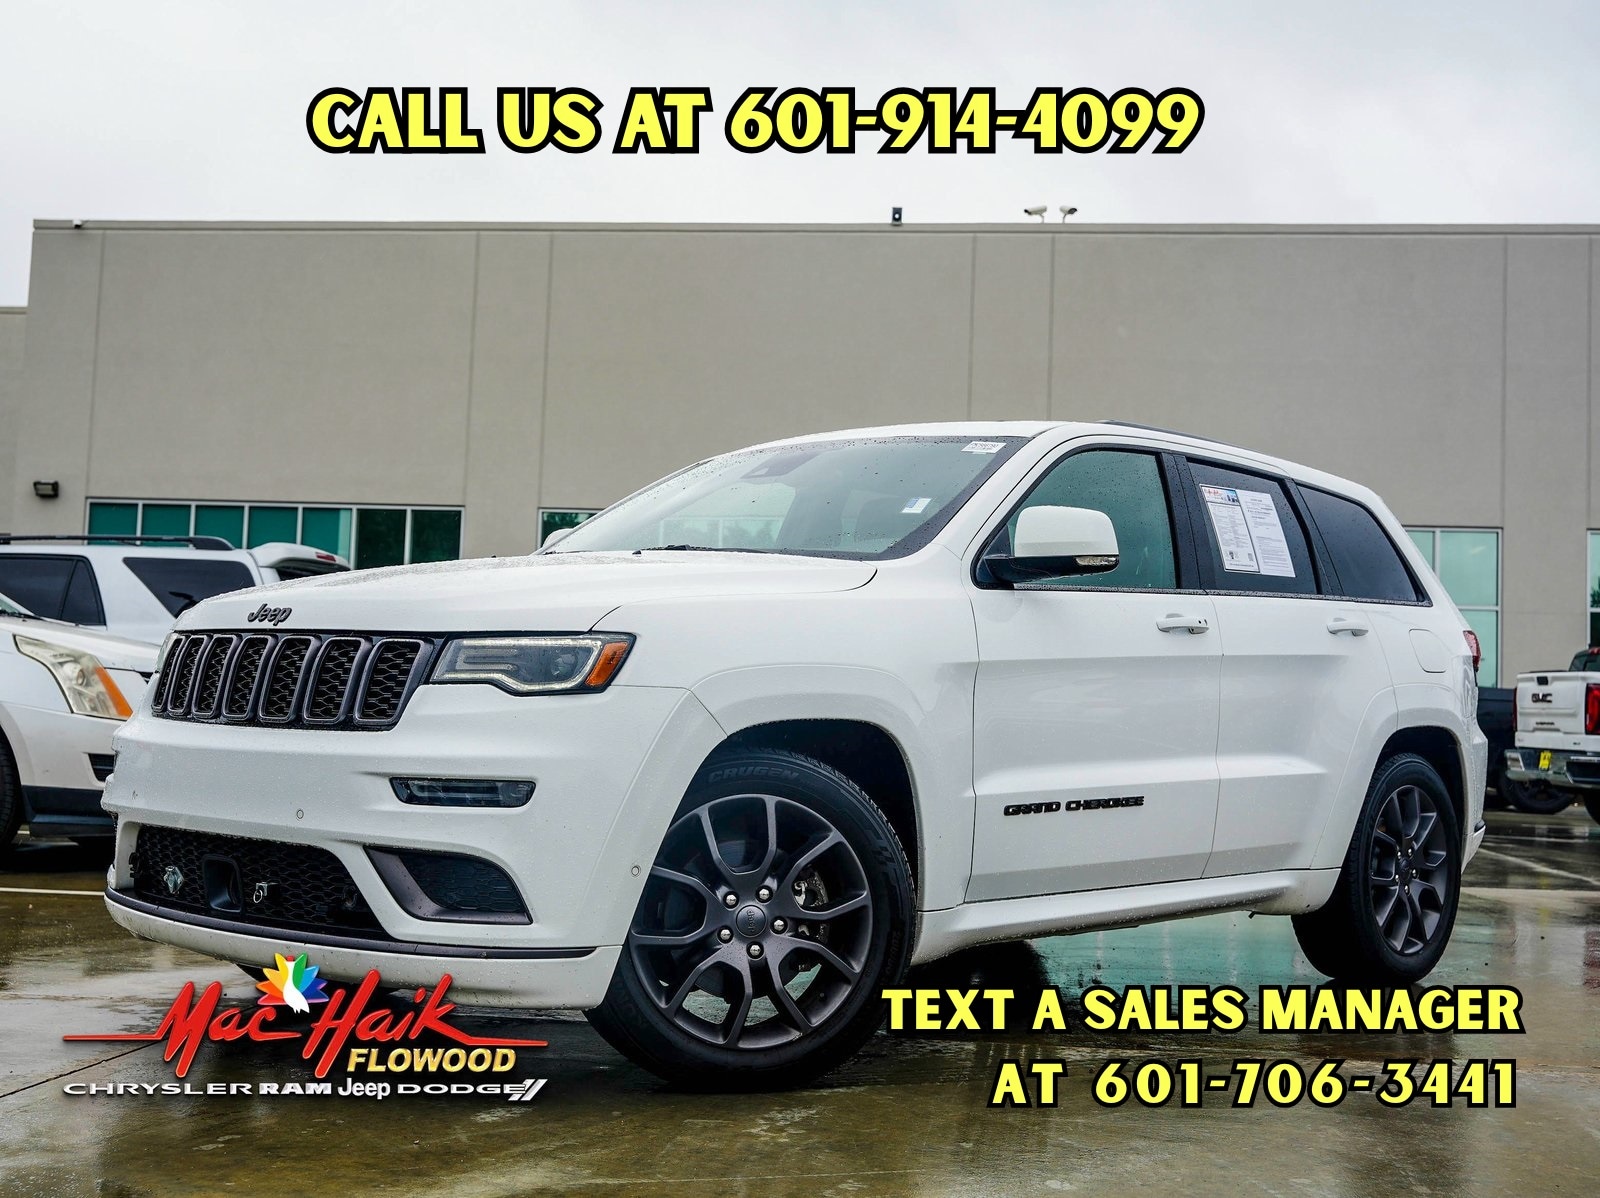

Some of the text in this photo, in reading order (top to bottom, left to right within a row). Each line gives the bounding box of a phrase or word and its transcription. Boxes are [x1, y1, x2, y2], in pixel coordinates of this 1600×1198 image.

[247, 603, 293, 626] Jeep
[1003, 795, 1145, 817] GRAND CHEROKEE
